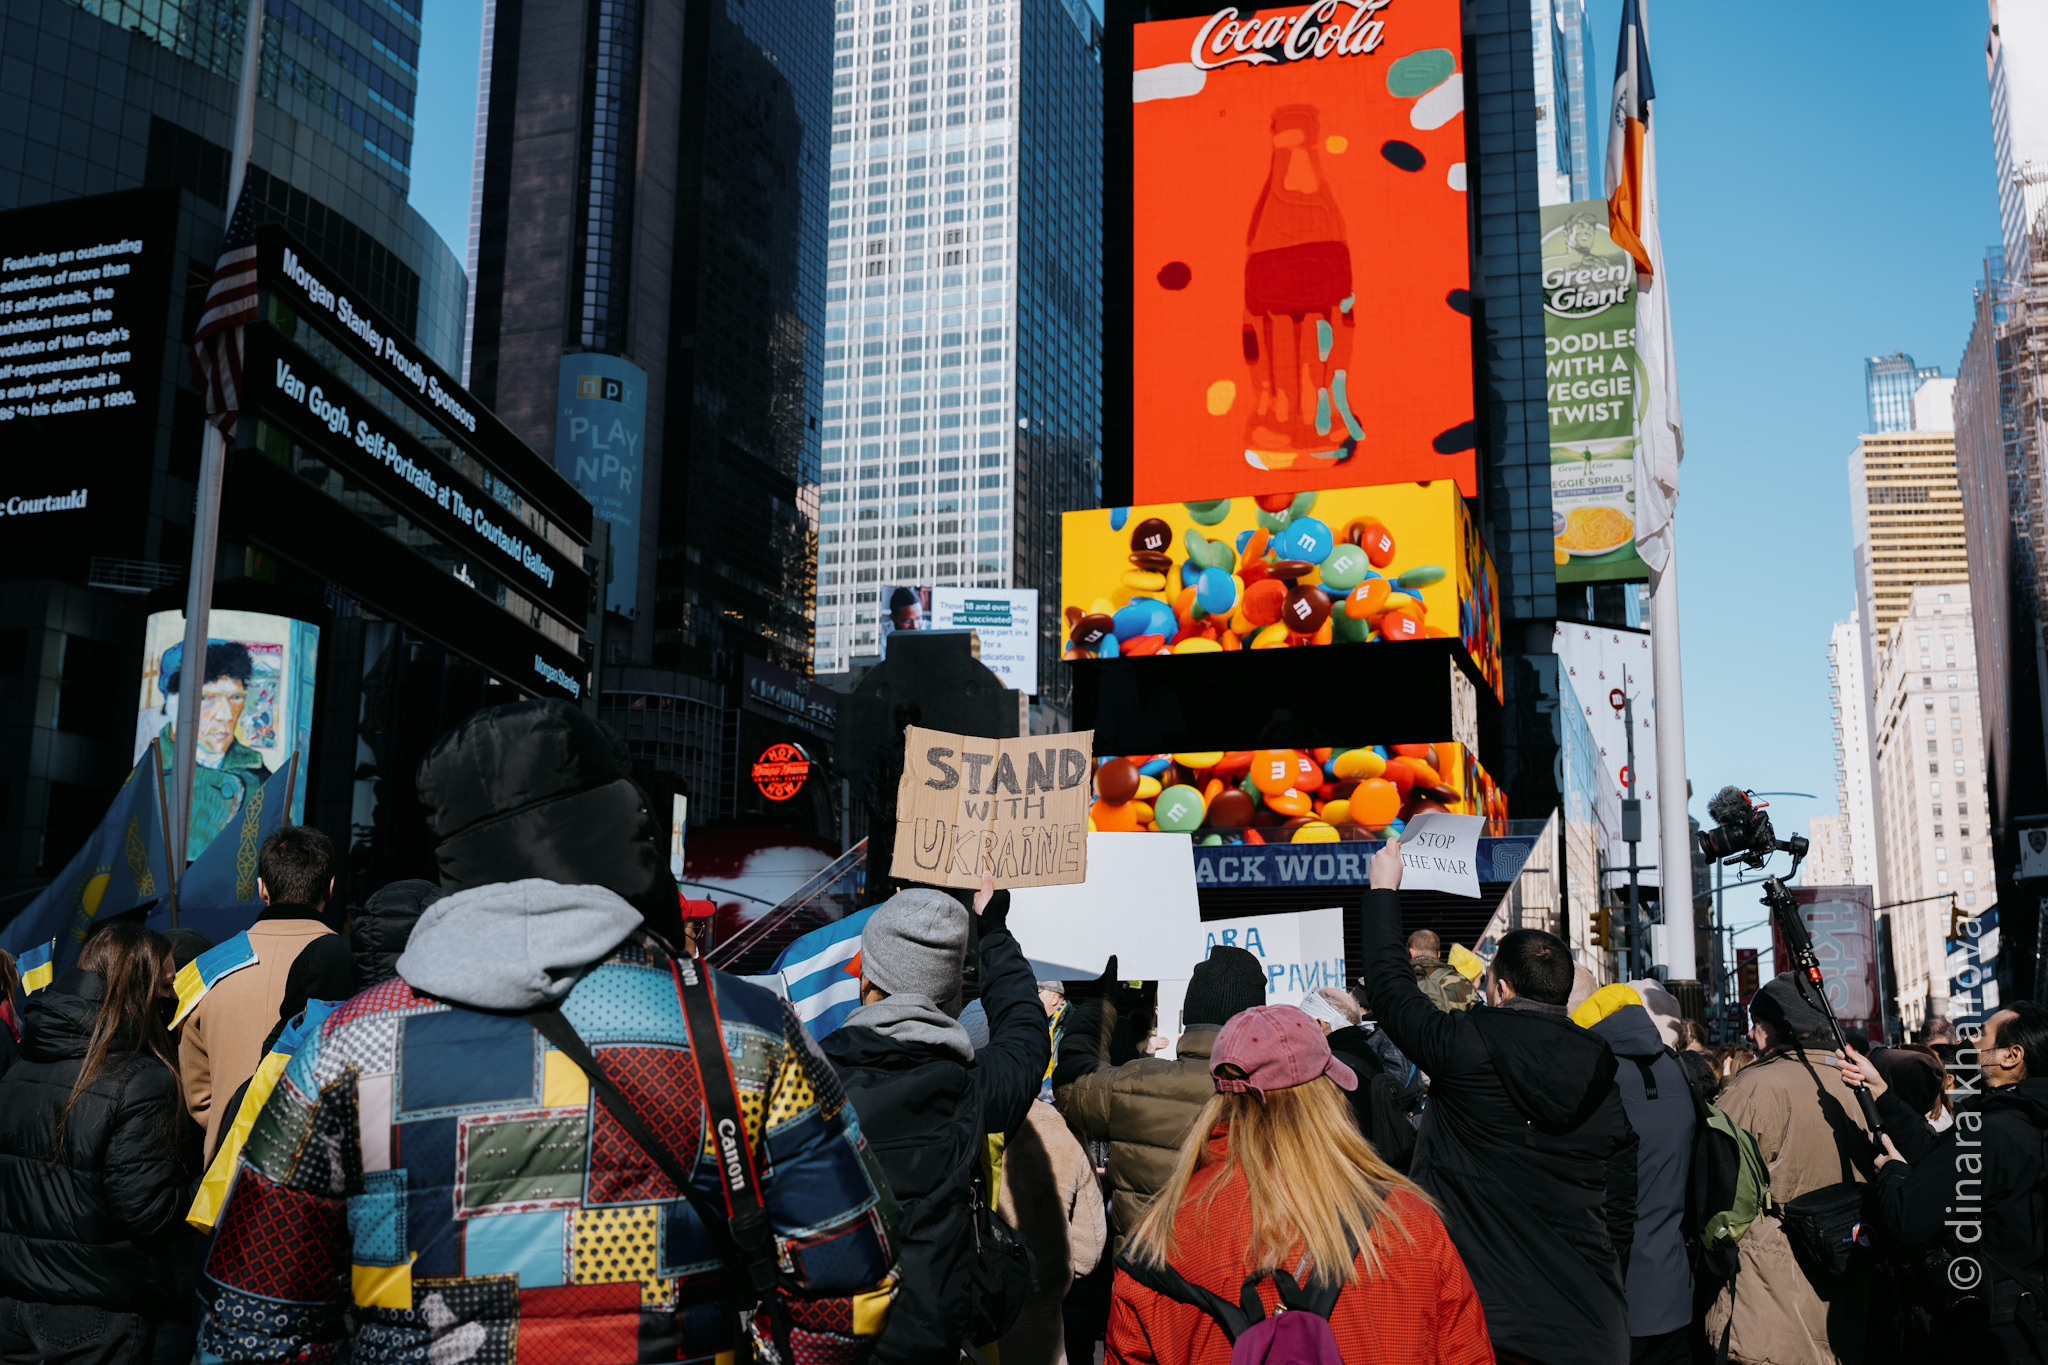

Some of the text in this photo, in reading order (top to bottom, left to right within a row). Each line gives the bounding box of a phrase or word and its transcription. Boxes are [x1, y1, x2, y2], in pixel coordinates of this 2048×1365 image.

[1191, 0, 1390, 69] Coca-Cola
[2, 239, 143, 271] Featuring an oustanding
[0, 263, 130, 293] selection of more than
[1542, 264, 1630, 311] Green Giant
[14, 290, 91, 312] self-portraits,
[93, 286, 115, 301] the
[0, 308, 113, 335] xhibition traces the
[47, 336, 62, 351] of
[62, 334, 85, 349] Van
[283, 247, 476, 432] Morgan Stanley Proudly Sponsors
[101, 351, 131, 365] from
[1546, 353, 1628, 378] WITH A
[7, 382, 37, 399] early
[37, 373, 107, 395] self-portrait
[108, 371, 121, 386] in
[31, 401, 50, 417] his
[51, 396, 87, 414] death
[88, 395, 101, 410] in
[103, 390, 136, 408] 1890.
[1548, 401, 1624, 426] TWIST
[276, 358, 554, 588] Van Gogh. Self-Portraits at The Courtauld Gallery
[1588, 473, 1633, 486] SPIRALS
[6, 488, 88, 515] Courtauld
[953, 614, 967, 623] not
[968, 614, 1012, 625] vaccinated
[965, 602, 974, 611] 18
[975, 603, 991, 611] and
[992, 604, 1010, 612] over
[984, 640, 995, 648] for
[997, 629, 1013, 638] part
[1016, 654, 1026, 662] to
[768, 748, 795, 760] HOT
[925, 747, 1086, 795] STAND
[765, 782, 795, 796] NOW
[965, 796, 1045, 821] WITH
[1417, 831, 1455, 849] STOP
[1401, 852, 1470, 876] THE WAR
[718, 1118, 745, 1191] Canon
